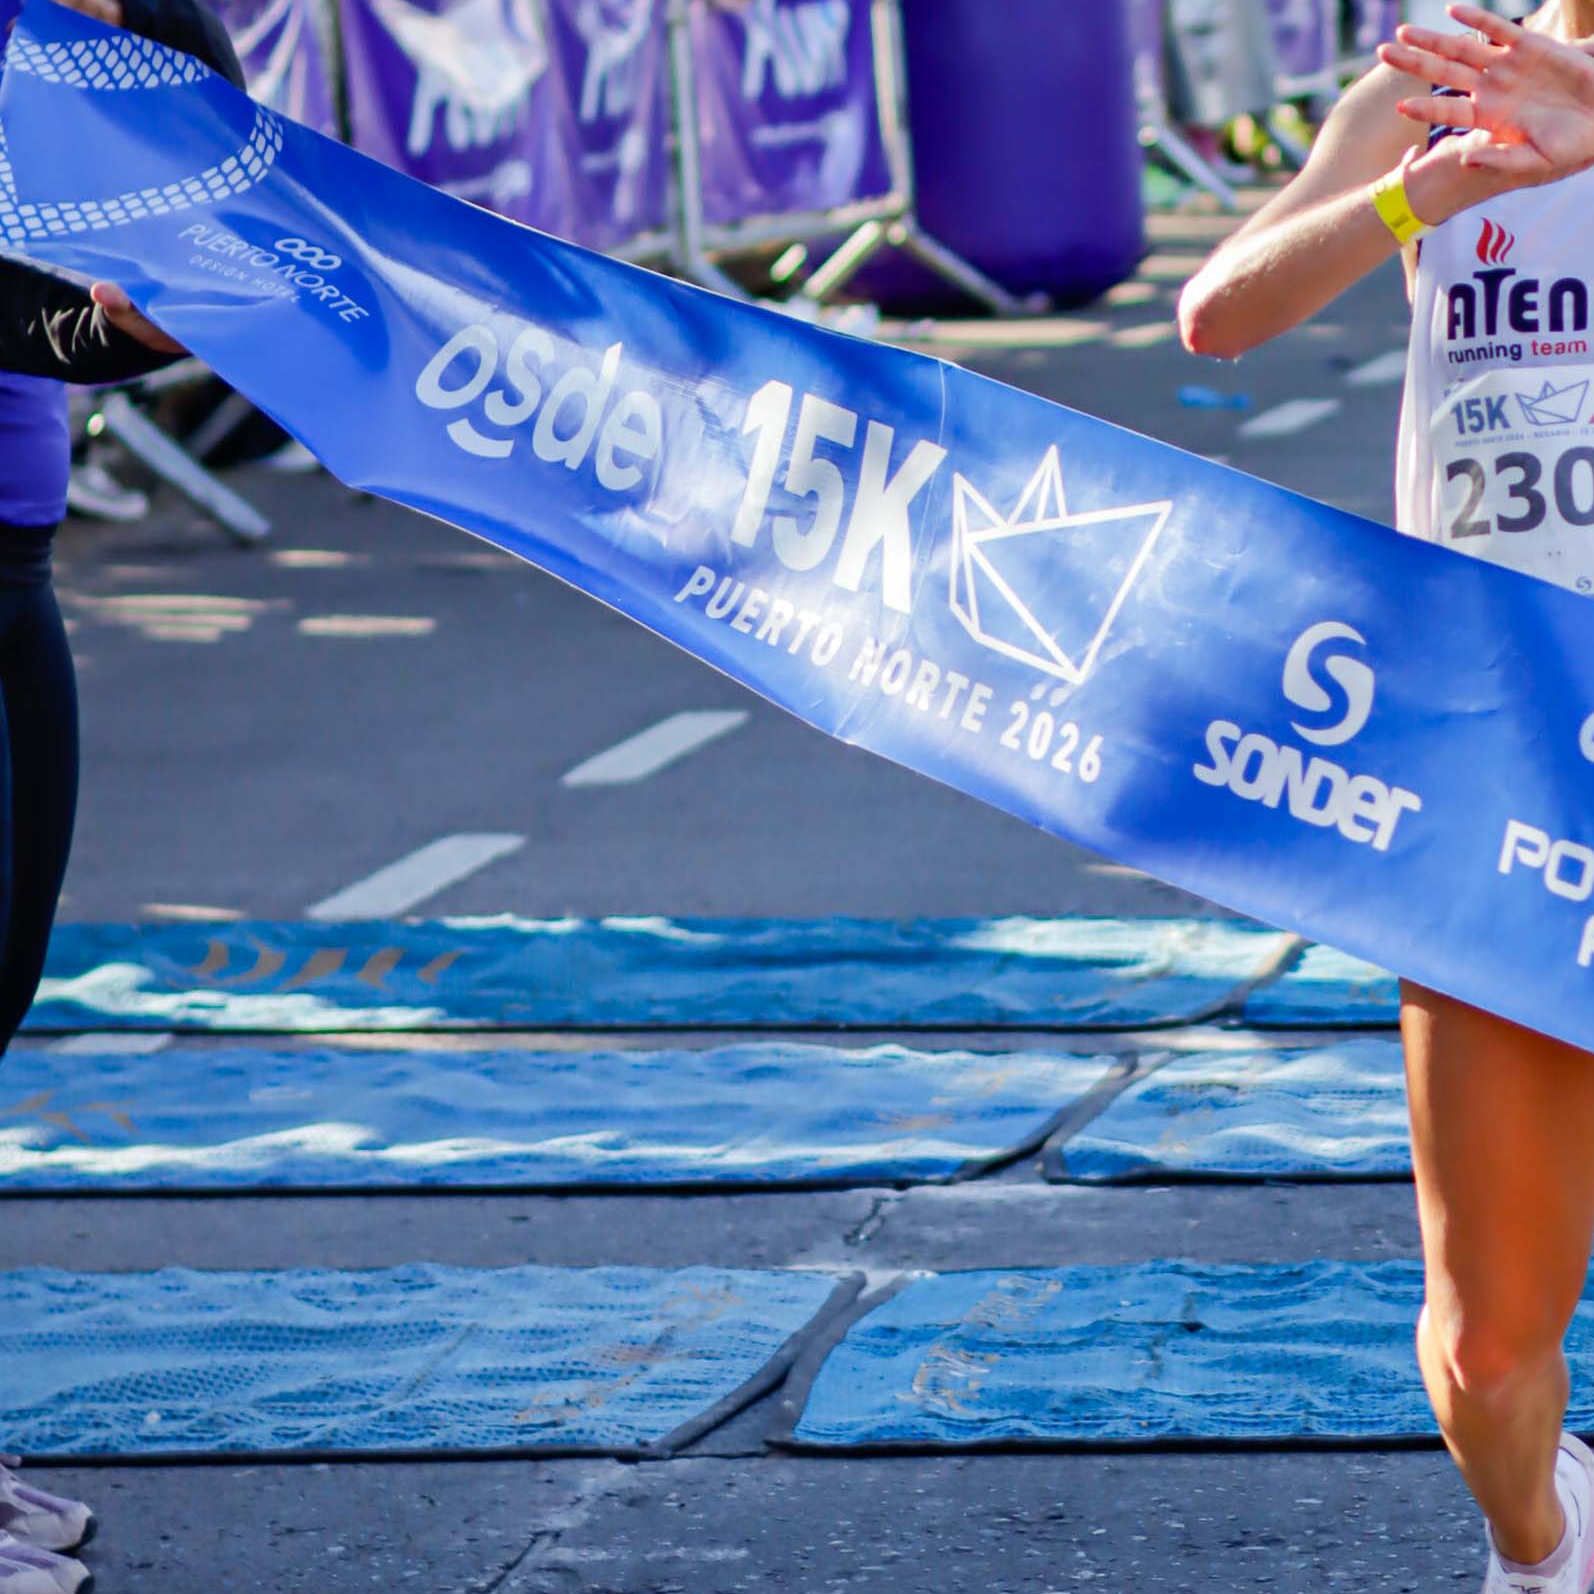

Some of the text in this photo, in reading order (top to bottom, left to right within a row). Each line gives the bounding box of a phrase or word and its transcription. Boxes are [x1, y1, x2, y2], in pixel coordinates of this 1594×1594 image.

[178, 224, 369, 322] PUERTO NORTE
[190, 255, 248, 281] DESIGN
[1448, 340, 1587, 363] running team
[1451, 395, 1511, 434] 15K
[730, 379, 948, 614] 15K
[673, 566, 1104, 783] PUERTO NORTE 2026
